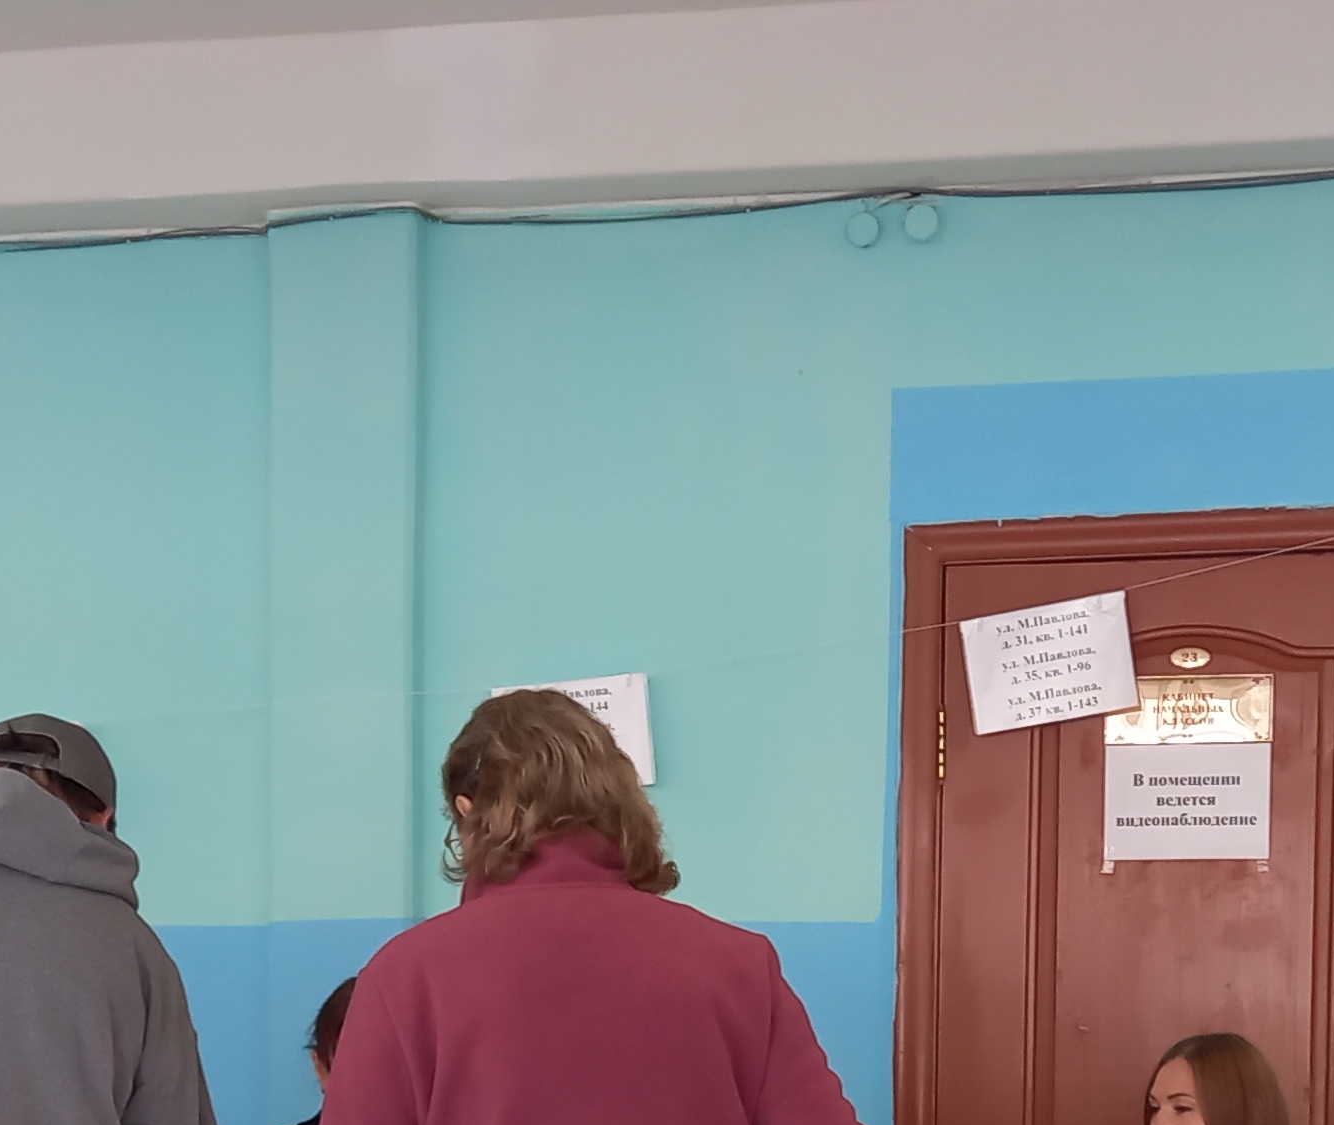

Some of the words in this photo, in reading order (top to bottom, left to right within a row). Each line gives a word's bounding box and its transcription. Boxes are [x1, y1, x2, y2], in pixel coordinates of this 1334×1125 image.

[996, 624, 1014, 637] ул.
[1016, 635, 1033, 647] 31,
[1035, 634, 1055, 644] кв.
[1058, 624, 1088, 639] 1-141
[1001, 661, 1020, 673] ул.
[1023, 646, 1097, 666] М.Павлова,
[1181, 653, 1198, 662] 23
[1024, 670, 1042, 682] 35,
[1044, 669, 1063, 678] кв.
[1067, 661, 1092, 674] 1-96
[1008, 697, 1026, 709] ул.
[1029, 682, 1103, 701] М.Павлова,
[1162, 693, 1215, 701] КАБИНЕТ
[1045, 706, 1064, 715] кв.
[1067, 696, 1098, 711] 1-143
[1133, 773, 1144, 786] В
[1148, 775, 1241, 787] помещении
[1156, 796, 1216, 807] ведется
[1115, 813, 1258, 827] видеонаблюдение
